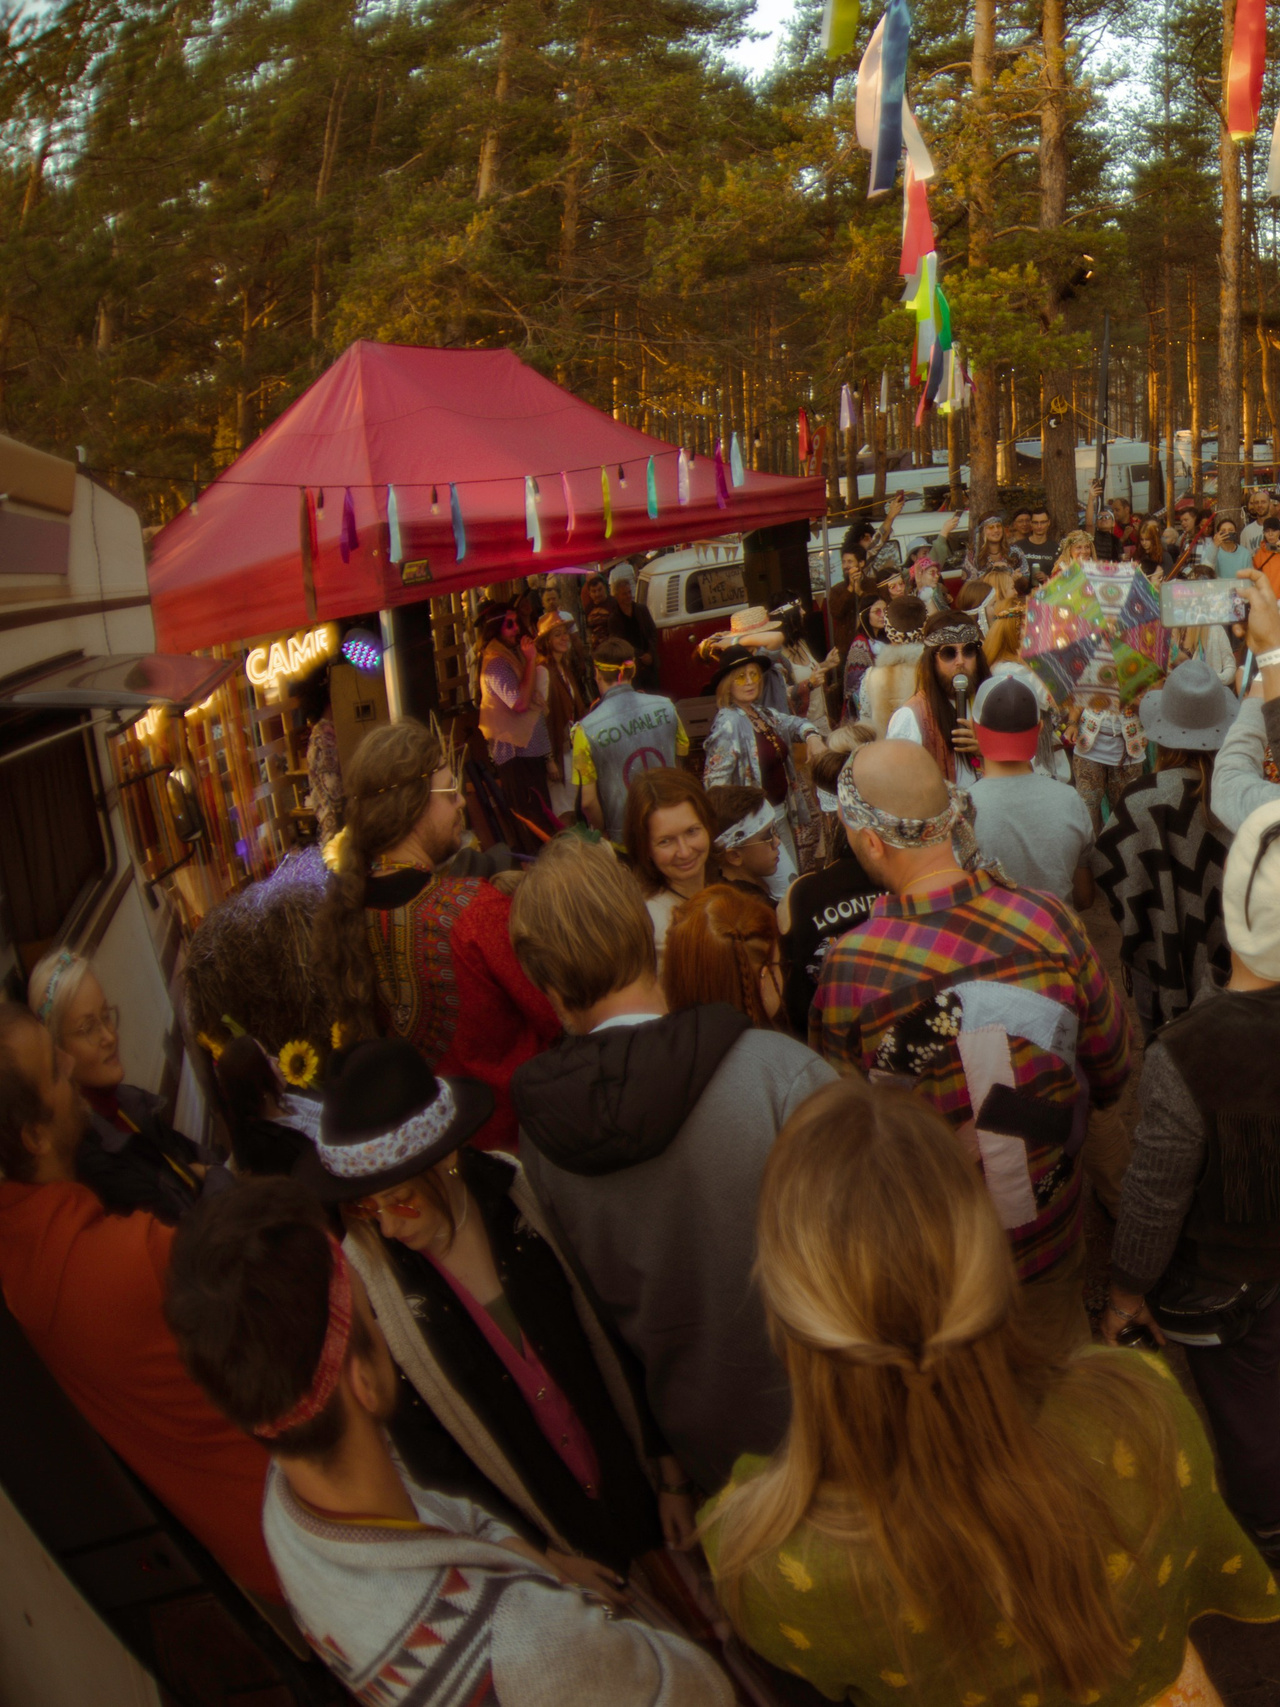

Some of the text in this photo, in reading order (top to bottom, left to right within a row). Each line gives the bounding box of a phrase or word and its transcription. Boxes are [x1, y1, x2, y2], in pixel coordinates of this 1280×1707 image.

[597, 708, 671, 748] GO VANLIFE
[812, 891, 889, 931] LOONE
